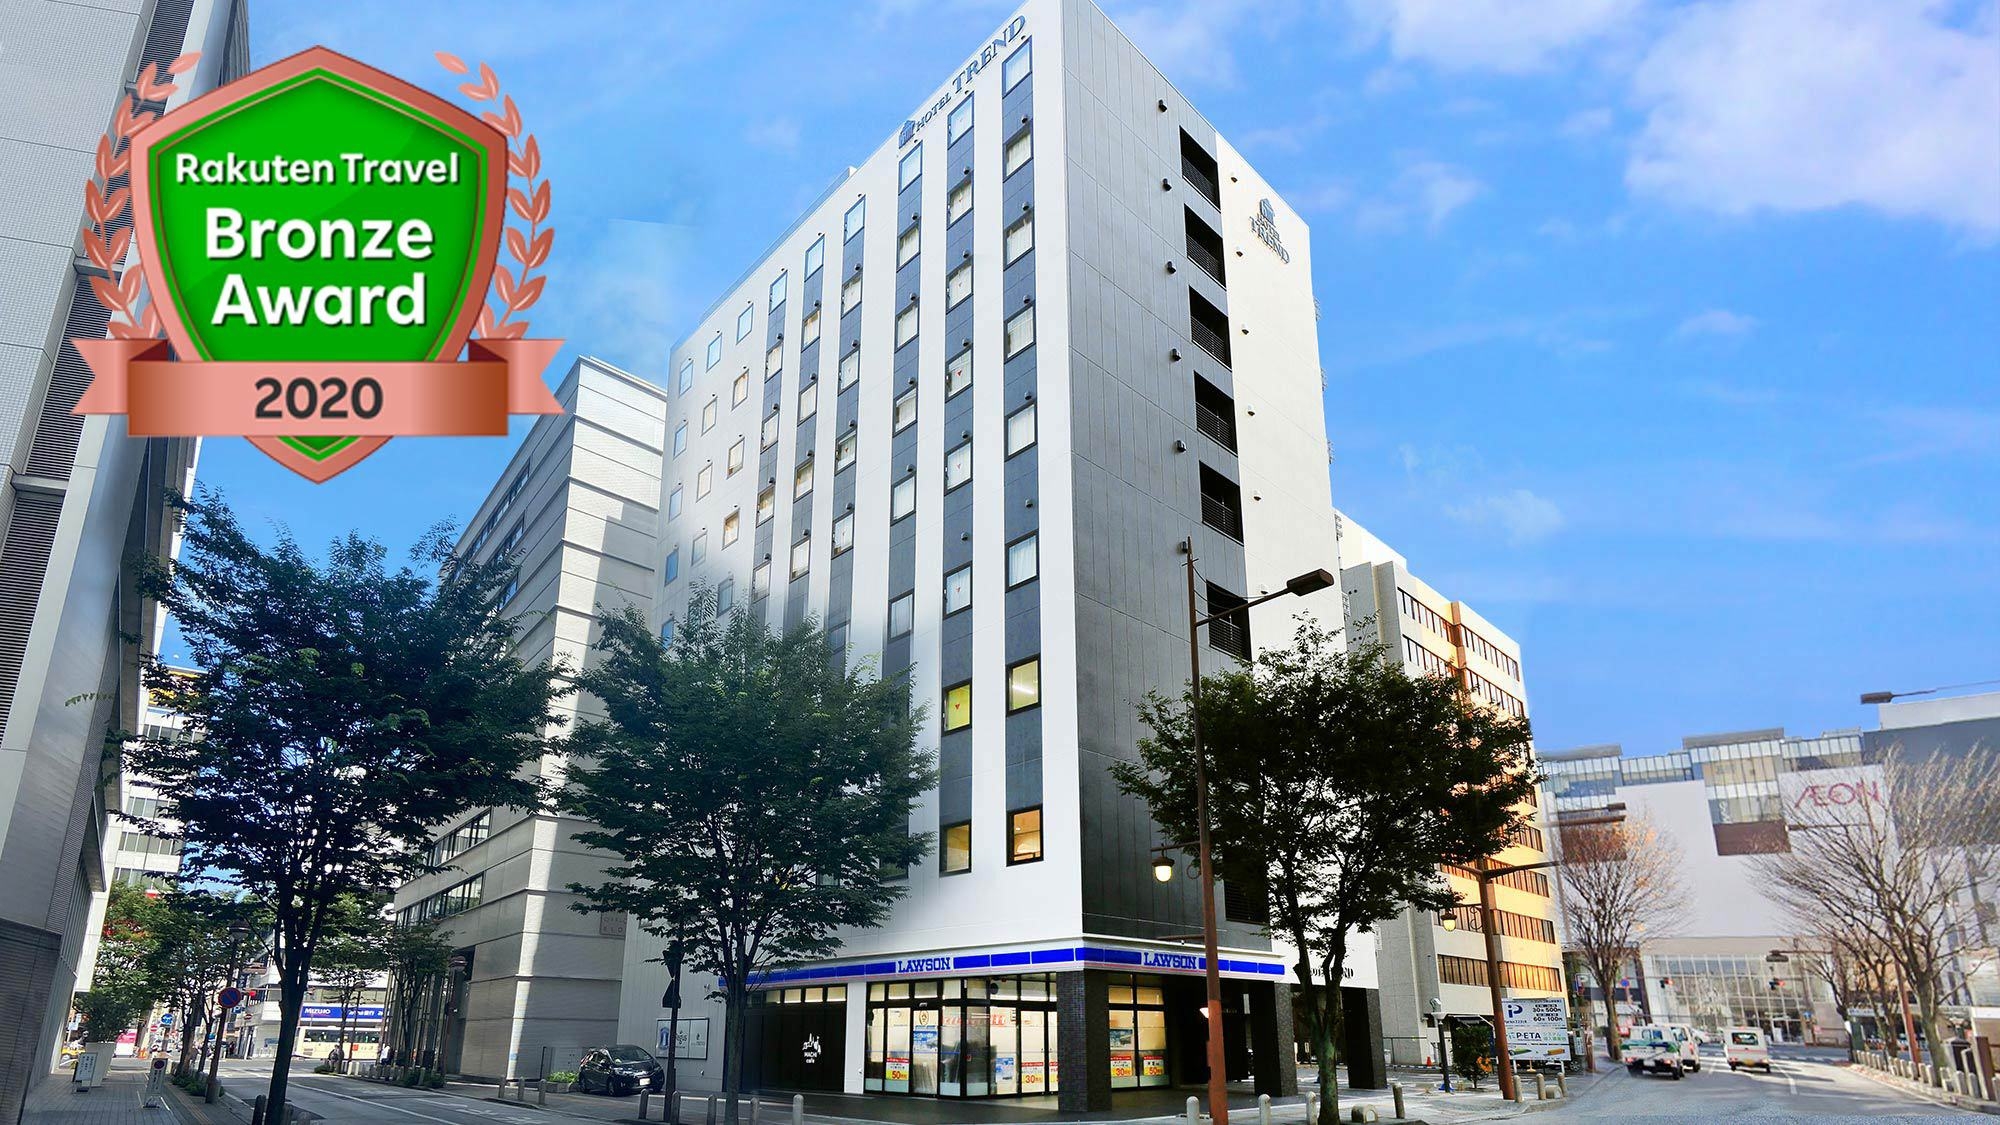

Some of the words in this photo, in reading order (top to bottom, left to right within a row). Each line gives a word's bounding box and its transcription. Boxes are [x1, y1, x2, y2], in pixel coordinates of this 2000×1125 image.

[916, 93, 951, 132] HOTEL
[952, 15, 1026, 94] TREND
[1249, 216, 1290, 263] TREND
[898, 957, 951, 973] LAWSON
[1144, 952, 1197, 969] LAWSON
